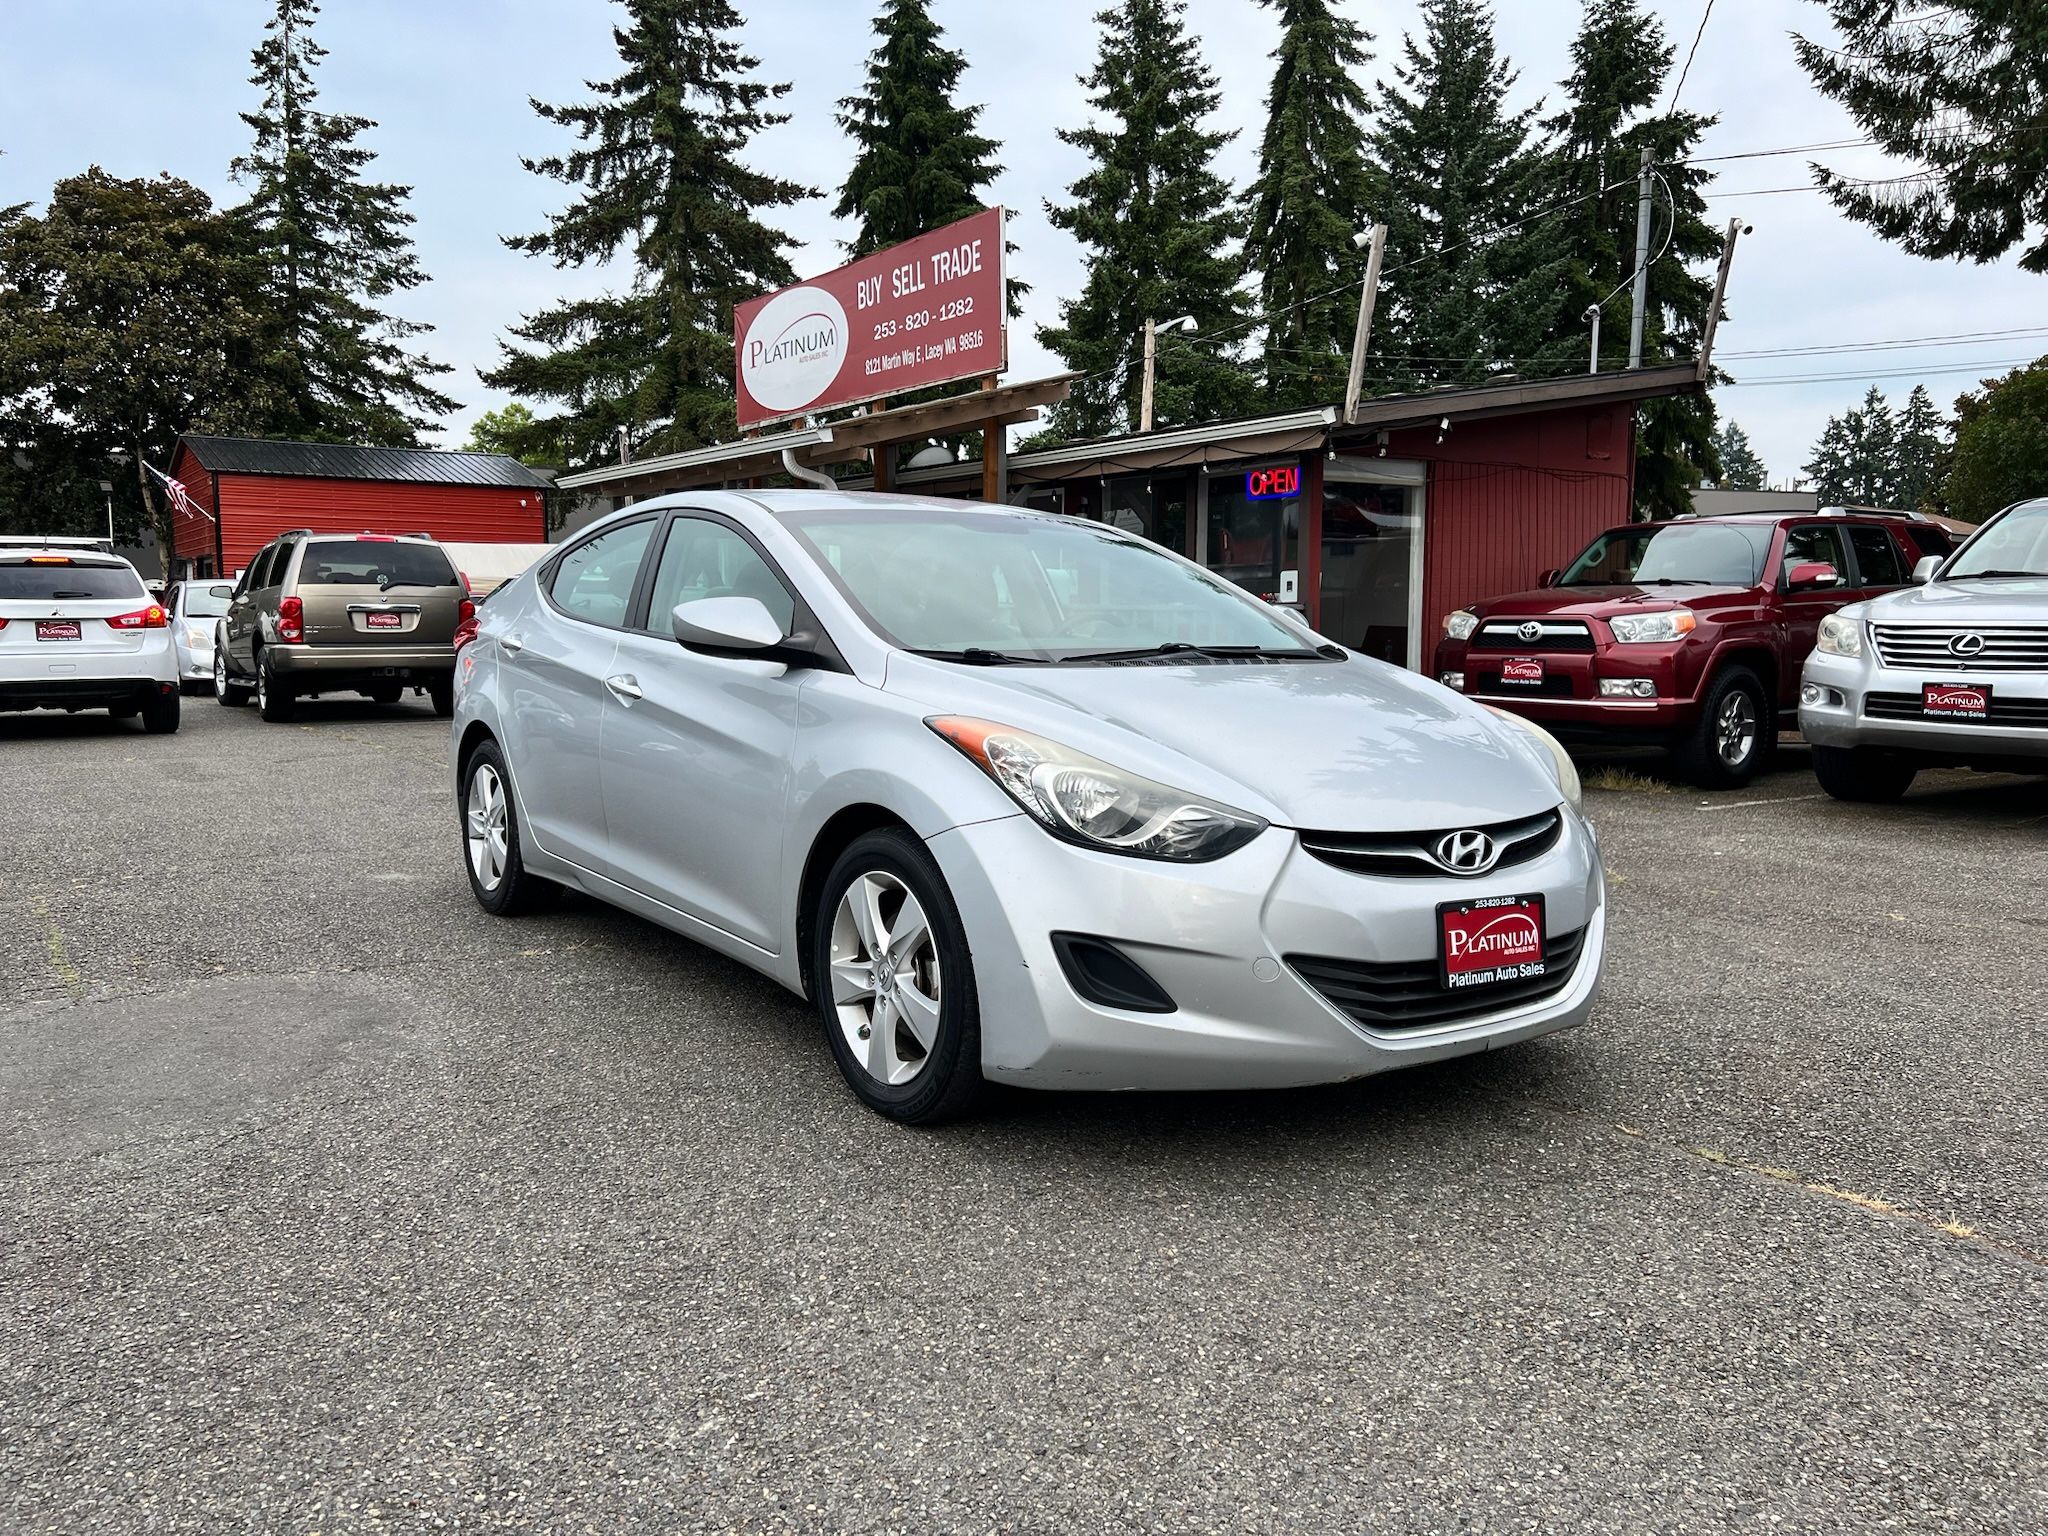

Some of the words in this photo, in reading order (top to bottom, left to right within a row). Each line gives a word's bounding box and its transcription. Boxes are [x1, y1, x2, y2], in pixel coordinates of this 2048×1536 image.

[857, 274, 882, 310] BUY
[892, 261, 925, 298] SELL
[931, 239, 982, 285] TRADE
[874, 320, 896, 340] 253
[905, 310, 929, 331] 820
[939, 296, 974, 321] 1282
[749, 328, 834, 369] PLATINUM
[865, 357, 881, 375] 8121
[882, 353, 901, 371] Martin
[902, 349, 915, 367] Way
[925, 344, 944, 361] Lacey
[944, 337, 957, 355] WA
[959, 329, 983, 351] 98516
[1249, 467, 1298, 496] OPEN
[1504, 665, 1541, 675] PLATINUM
[1927, 693, 1985, 706] PLATINUM
[1952, 709, 1967, 717] Auto
[1475, 897, 1515, 908] 253-820-1282
[1448, 929, 1537, 956] PLATINUM
[1503, 947, 1514, 955] AUTO
[1449, 971, 1494, 988] Platinum
[1496, 967, 1518, 981] Auto
[1520, 962, 1545, 977] Sales
